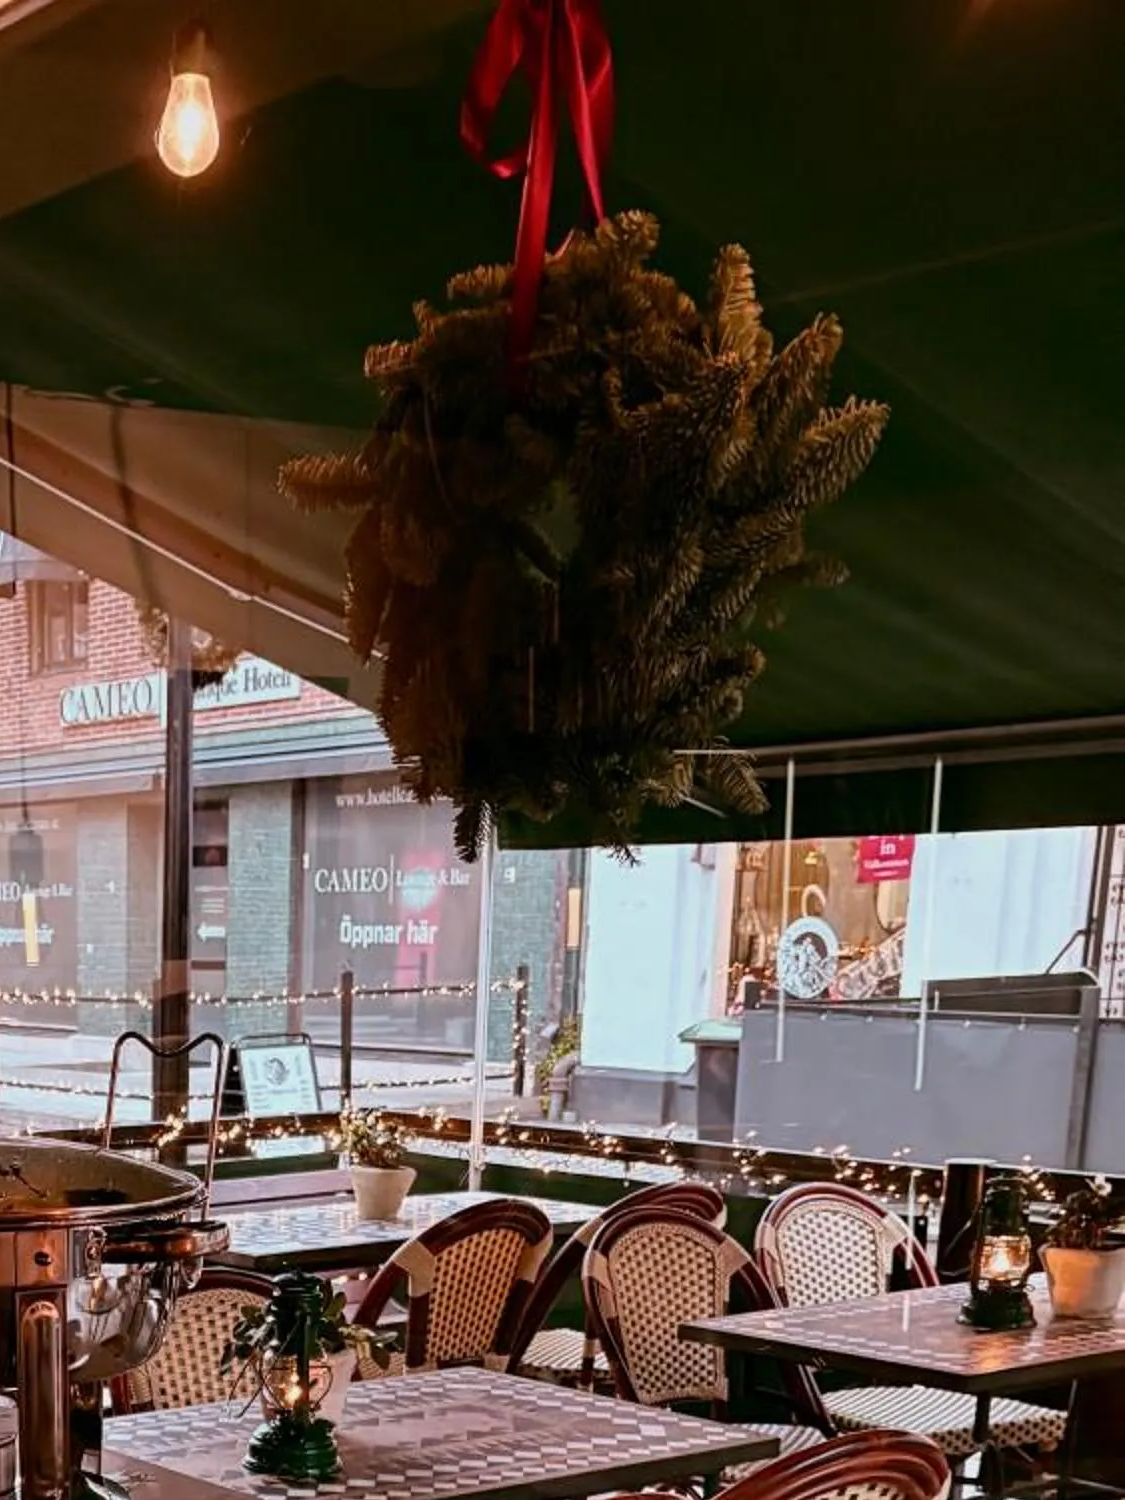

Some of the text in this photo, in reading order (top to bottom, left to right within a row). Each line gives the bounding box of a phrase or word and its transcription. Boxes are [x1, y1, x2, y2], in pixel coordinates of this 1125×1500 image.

[60, 679, 152, 725] CAMEO
[314, 867, 388, 893] CAMEO
[450, 867, 470, 886] Bar
[339, 914, 438, 948] Öppnar här
